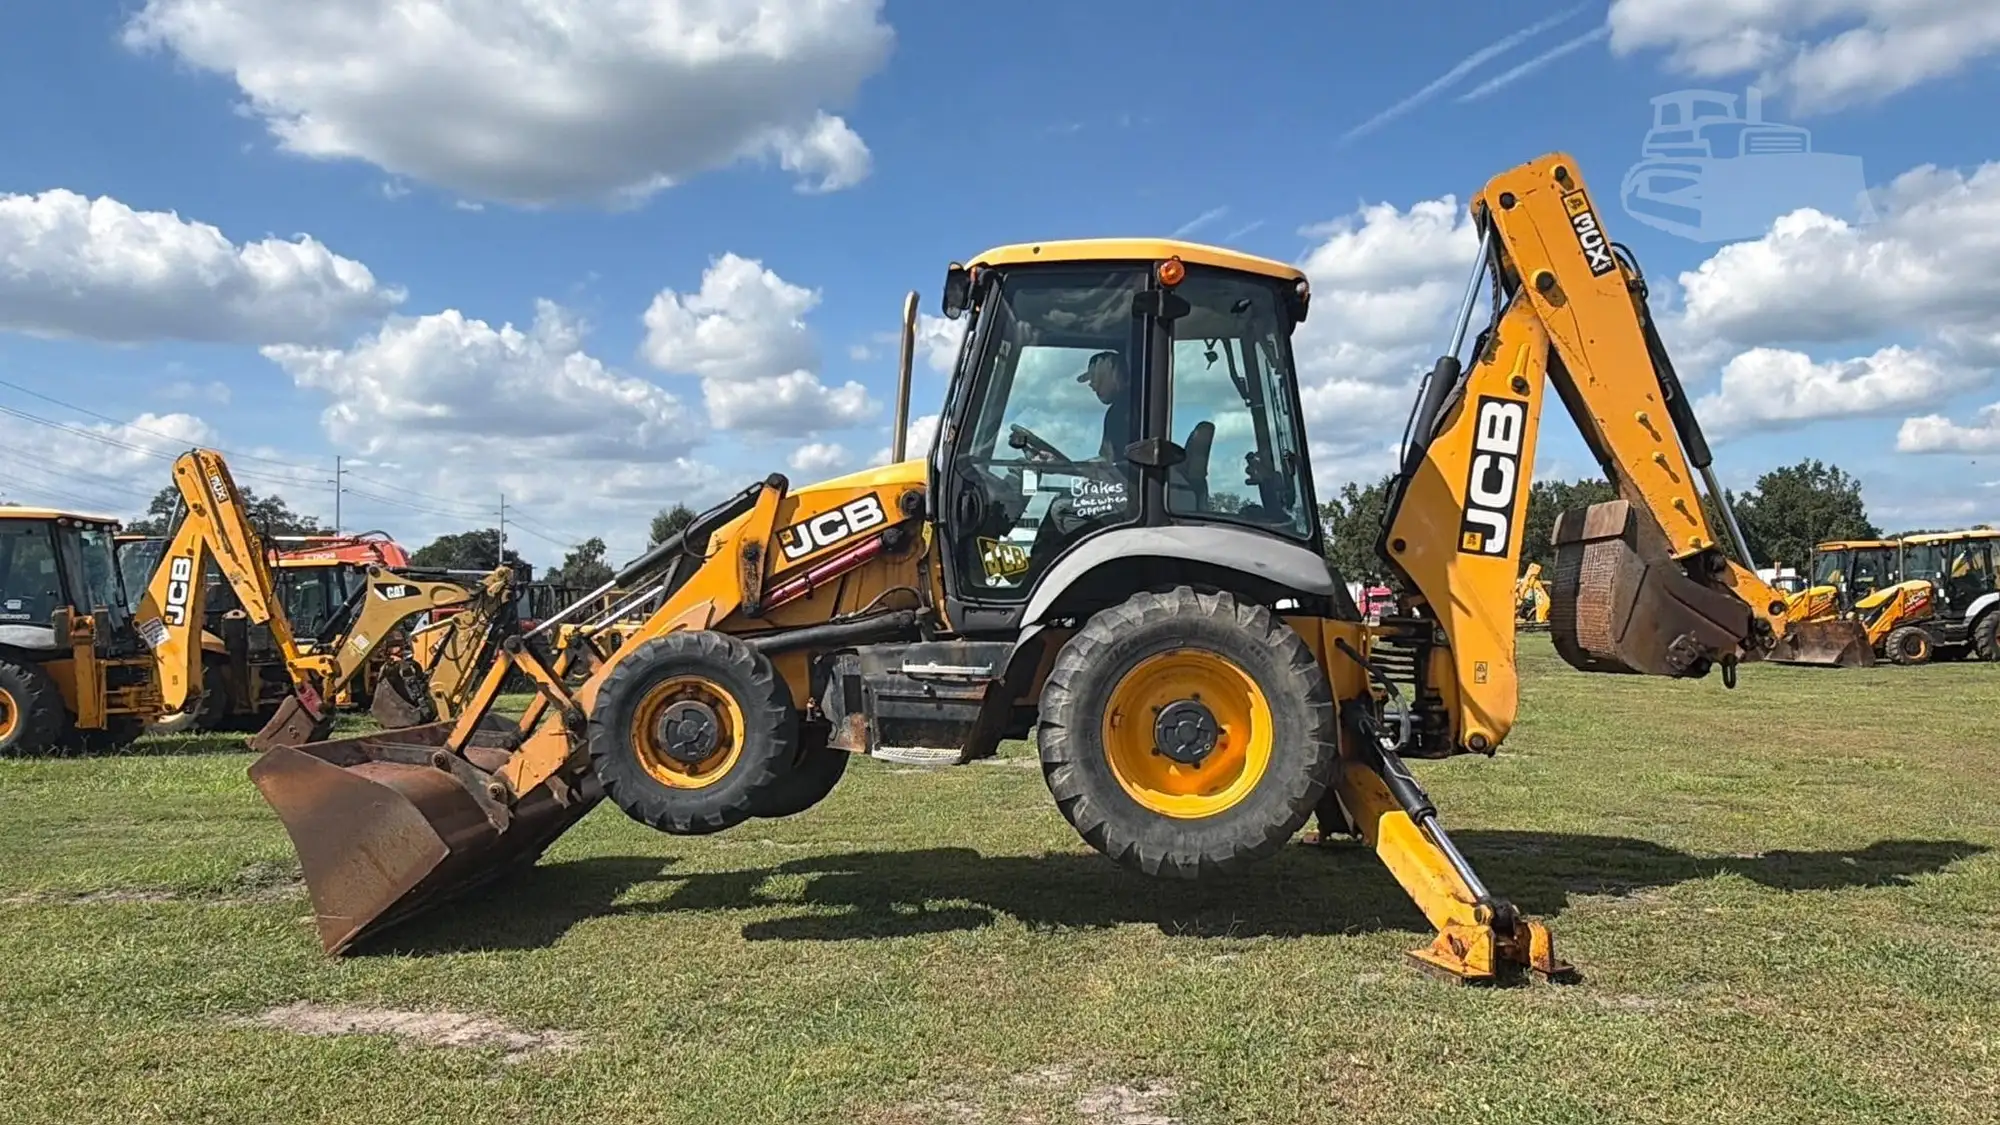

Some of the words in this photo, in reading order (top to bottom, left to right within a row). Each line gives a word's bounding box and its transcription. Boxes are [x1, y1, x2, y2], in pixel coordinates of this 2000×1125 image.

[1573, 212, 1612, 267] 3CX
[1071, 476, 1124, 497] Brakes
[1467, 402, 1523, 553] JCB
[784, 496, 883, 558] JCB
[985, 541, 1026, 575] JCB
[166, 558, 191, 625] JCB
[386, 584, 406, 599] CAT
